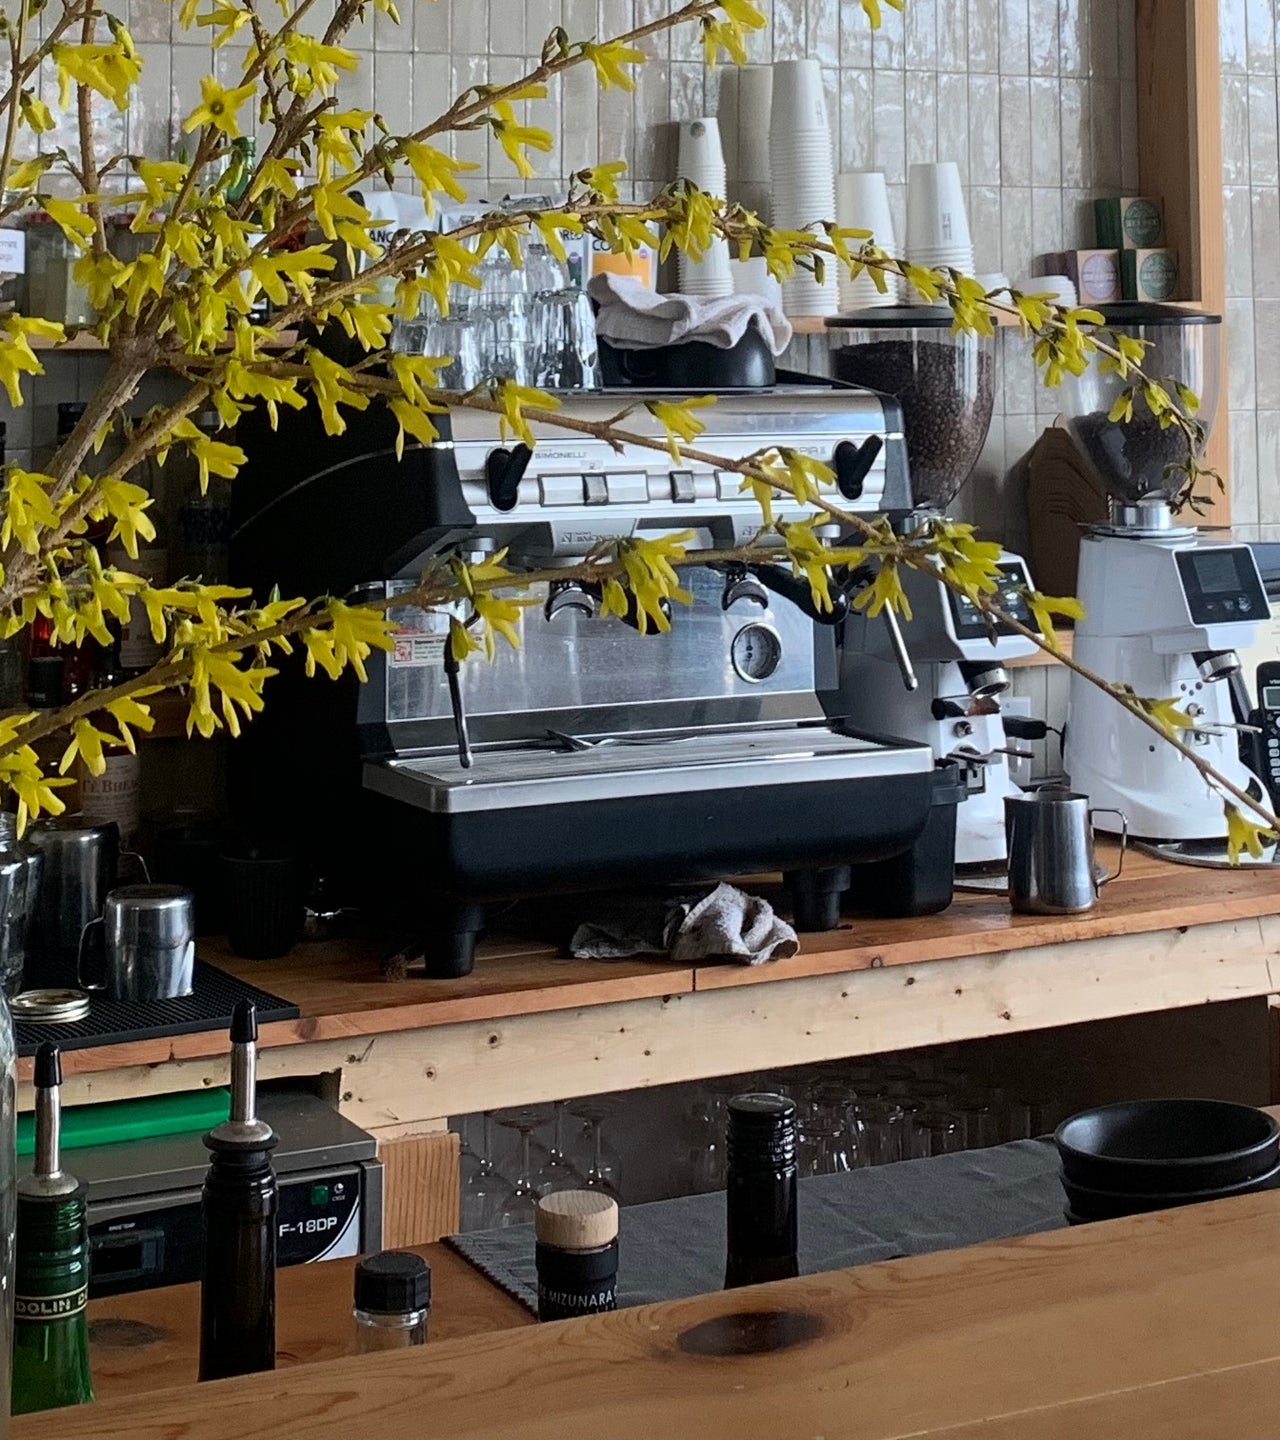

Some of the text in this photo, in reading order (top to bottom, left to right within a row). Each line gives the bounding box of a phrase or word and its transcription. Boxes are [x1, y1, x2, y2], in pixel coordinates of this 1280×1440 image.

[534, 452, 588, 460] SIMONELLI
[278, 1216, 338, 1237] F-18DP
[15, 1298, 70, 1314] DOLIN
[549, 1290, 613, 1308] MIZUNARA
